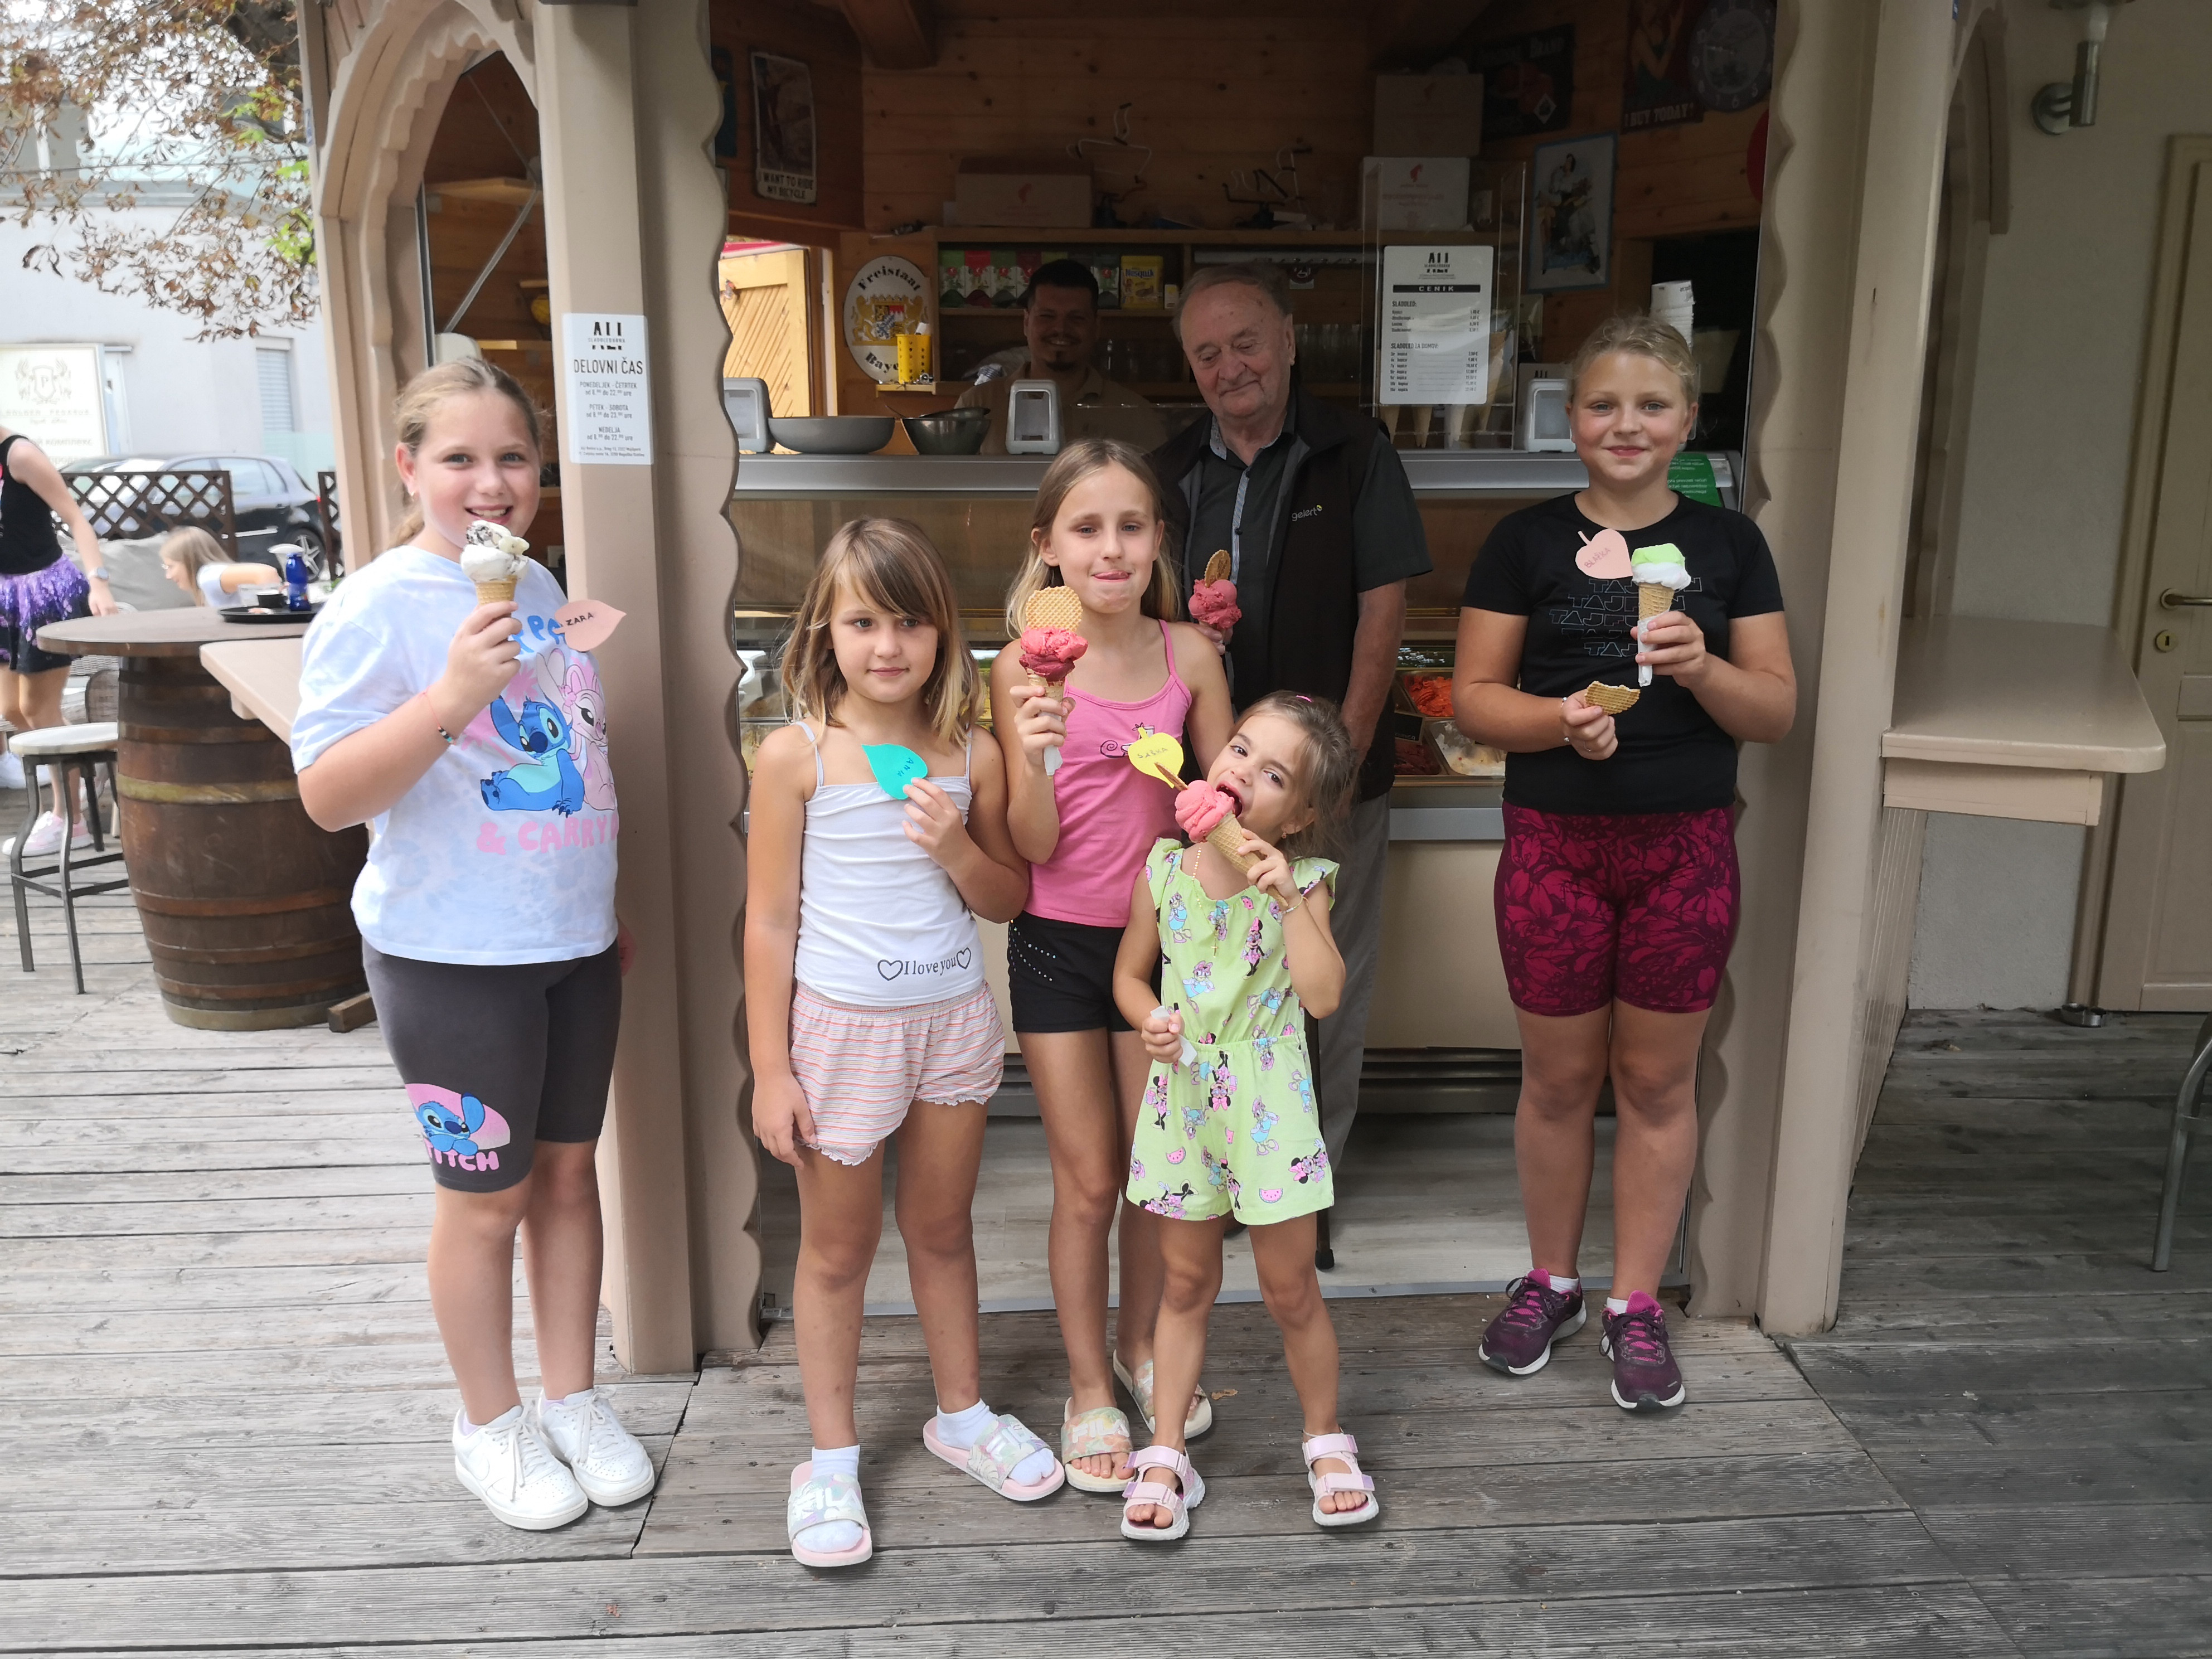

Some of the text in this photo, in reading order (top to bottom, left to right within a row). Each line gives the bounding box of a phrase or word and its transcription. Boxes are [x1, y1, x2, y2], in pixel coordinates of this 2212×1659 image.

[787, 176, 796, 186] TO
[857, 266, 921, 291] Freistaat
[1126, 269, 1154, 278] Nesquik
[574, 357, 643, 375] DELOVNI ČAS
[865, 352, 899, 373] Baye
[1292, 507, 1318, 522] gelert
[1584, 547, 1611, 569] BLAŽKA
[565, 612, 595, 626] ZARA
[1549, 609, 1638, 627] TAJFU
[1137, 748, 1168, 759] SAŠKA
[477, 822, 506, 855] &
[518, 814, 608, 853] CARRY
[904, 955, 957, 977] I love you
[423, 1138, 499, 1172] TITCH
[1072, 1419, 1130, 1443] FILA
[986, 1422, 1040, 1462] FIL
[792, 1487, 862, 1520] FILA
